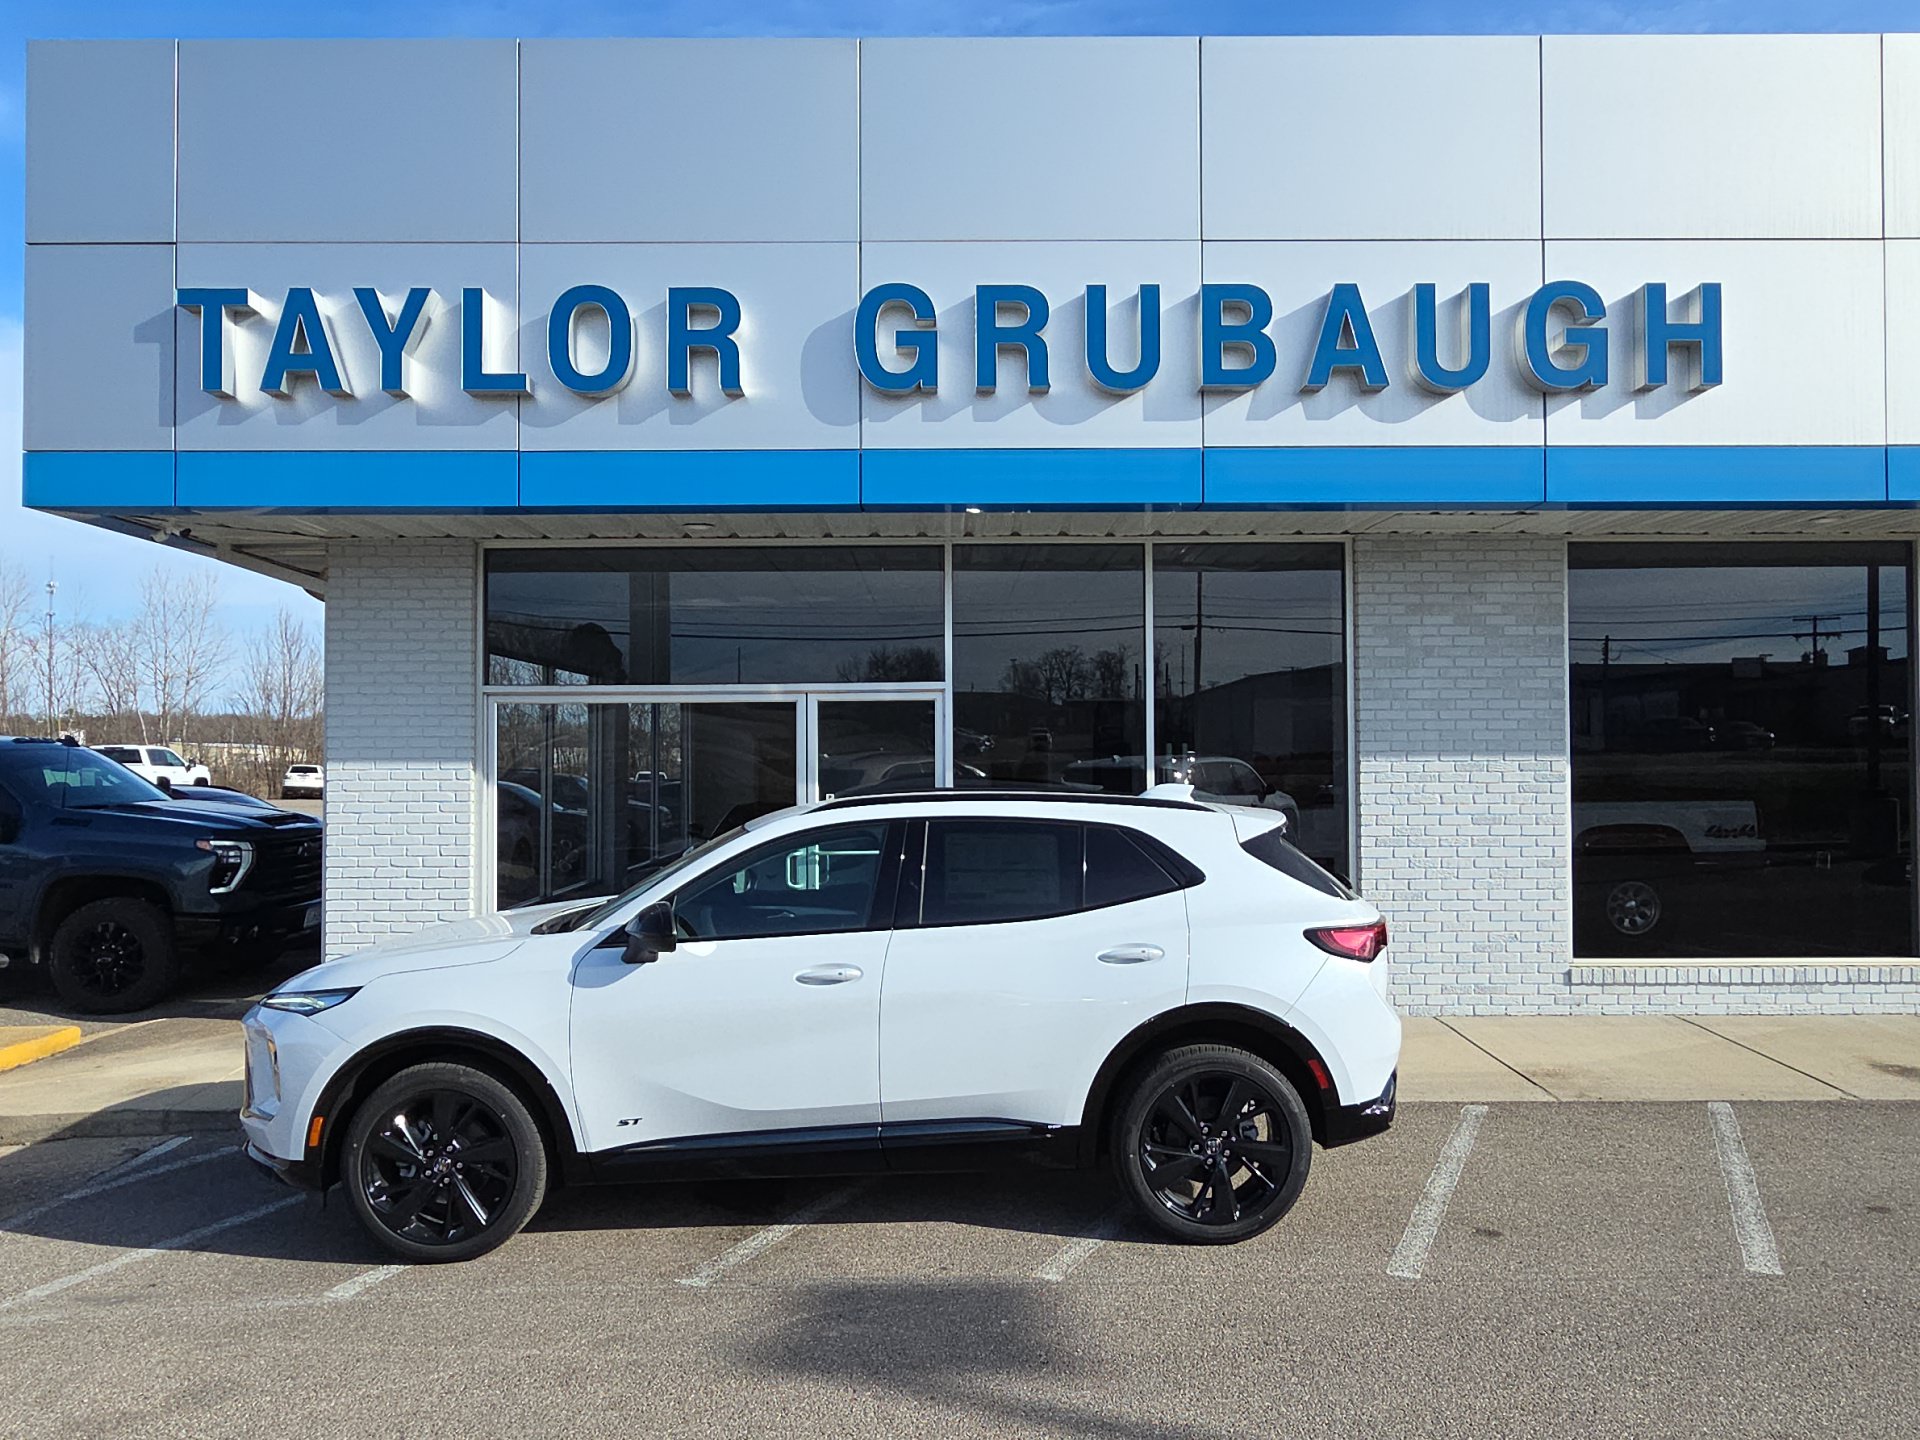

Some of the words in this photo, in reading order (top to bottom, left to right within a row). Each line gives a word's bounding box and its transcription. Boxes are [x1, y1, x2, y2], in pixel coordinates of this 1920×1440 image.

[176, 284, 742, 396] TAYLOR
[854, 281, 1722, 394] GRUBAUGH
[616, 1117, 643, 1127] ST
